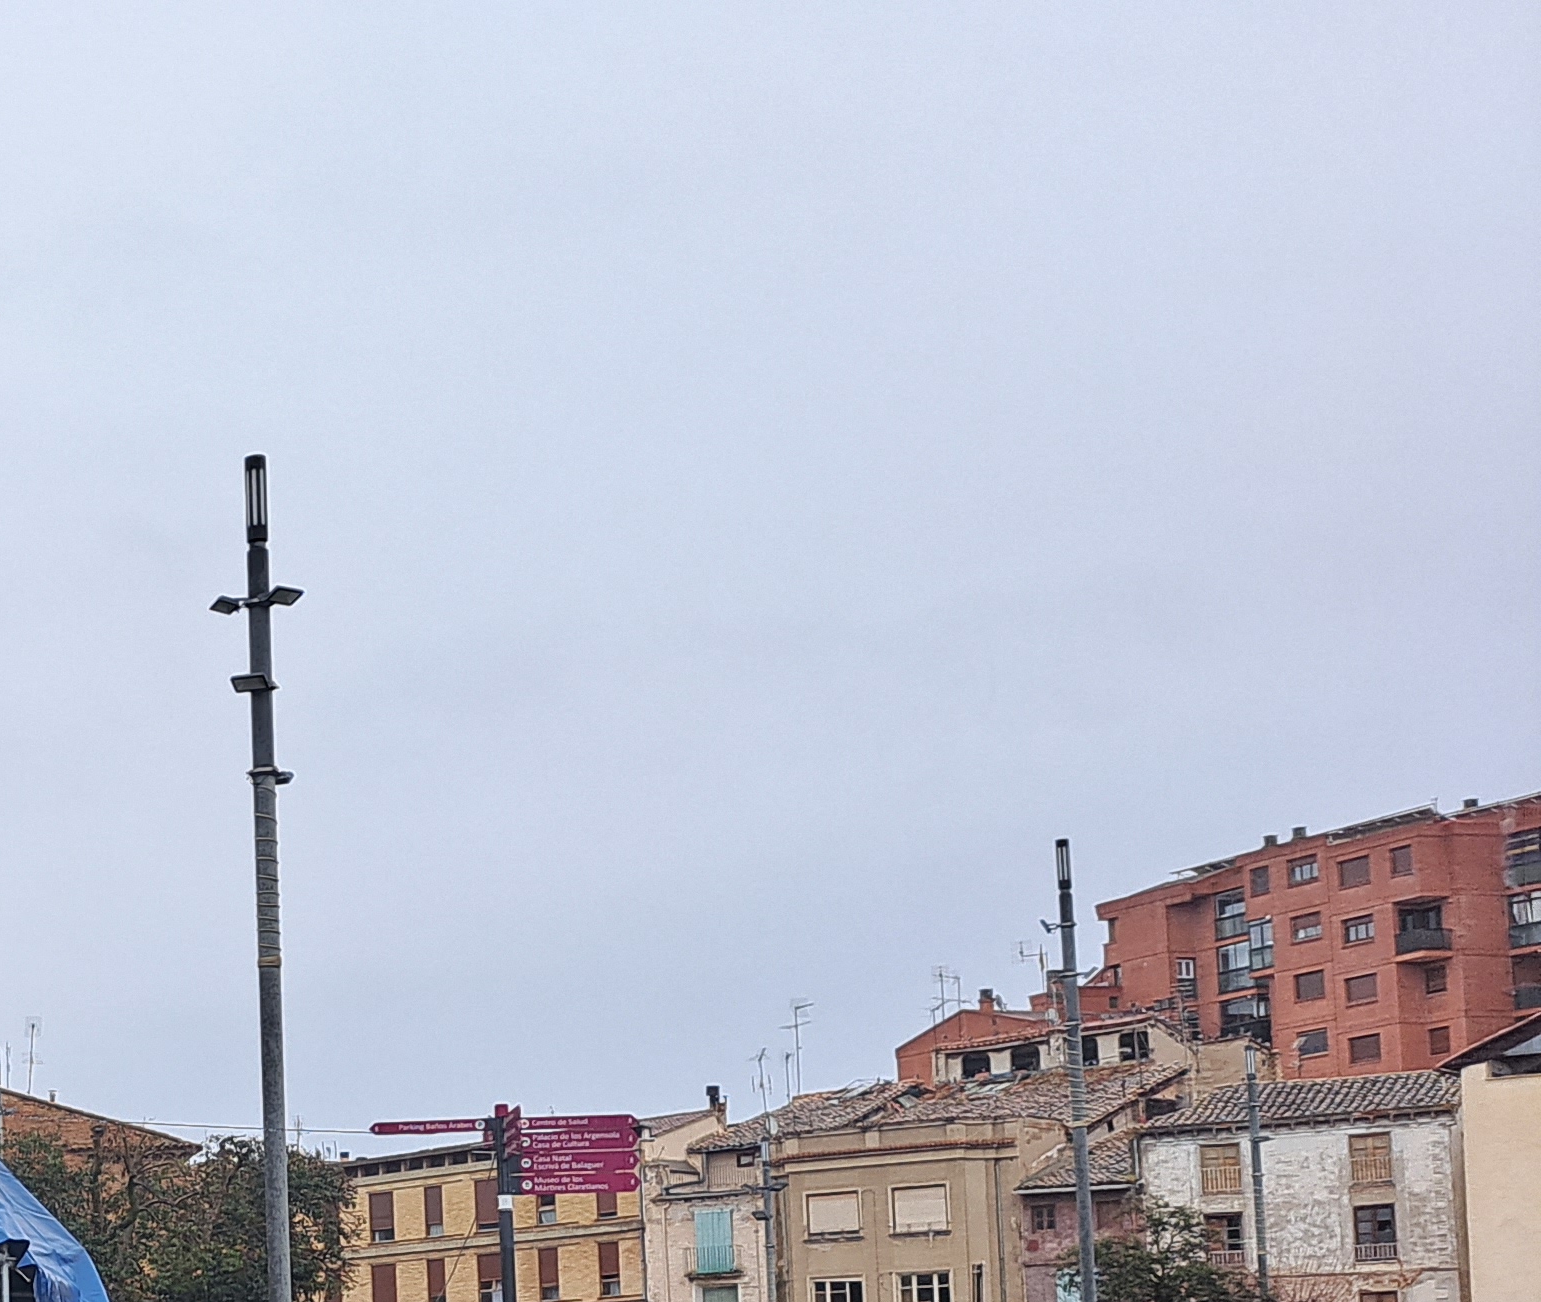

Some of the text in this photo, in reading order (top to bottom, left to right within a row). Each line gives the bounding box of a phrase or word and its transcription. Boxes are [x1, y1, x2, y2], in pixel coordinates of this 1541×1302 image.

[398, 1123, 425, 1131] Parking
[583, 1132, 620, 1140] Argensola
[571, 1161, 604, 1169] Balaguer
[567, 1183, 609, 1191] Claretianos
